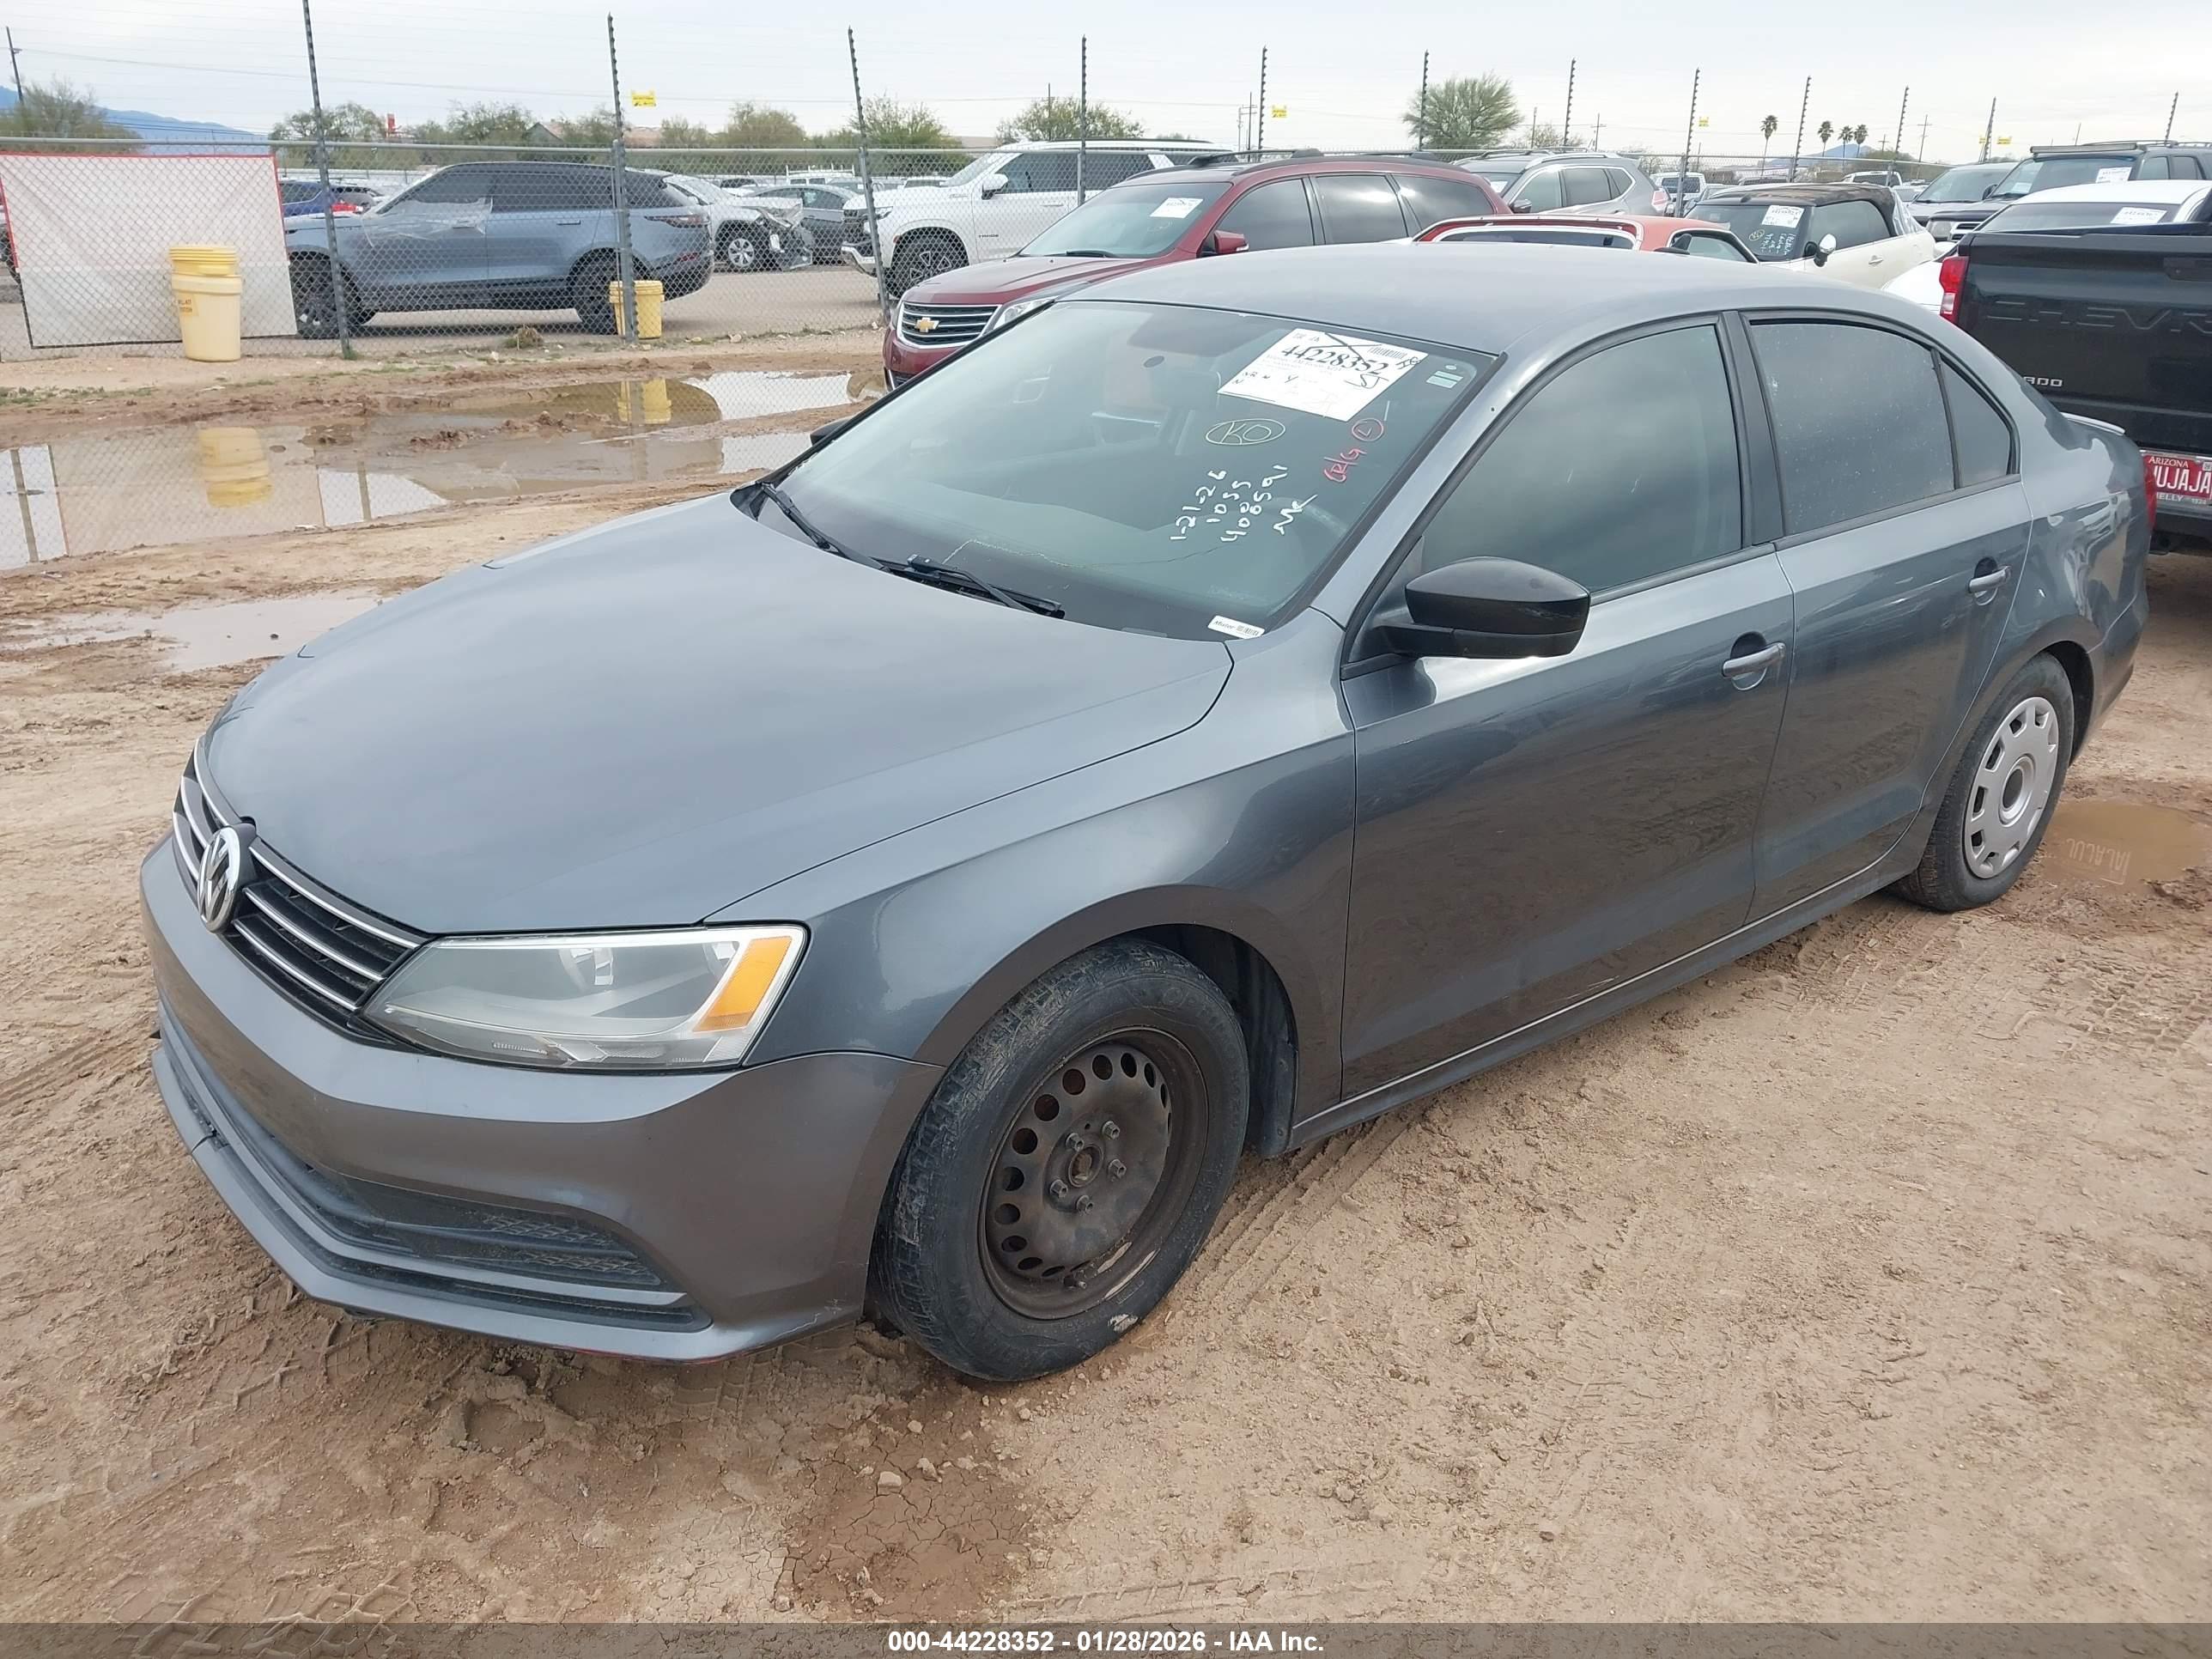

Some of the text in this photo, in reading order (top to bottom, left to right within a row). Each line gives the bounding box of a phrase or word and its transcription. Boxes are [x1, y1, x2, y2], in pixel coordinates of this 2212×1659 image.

[1281, 345, 1389, 374] 44228352
[2148, 456, 2189, 468] ARIZONA
[2154, 465, 2212, 495] UJAJA
[2156, 492, 2184, 501] ELLY
